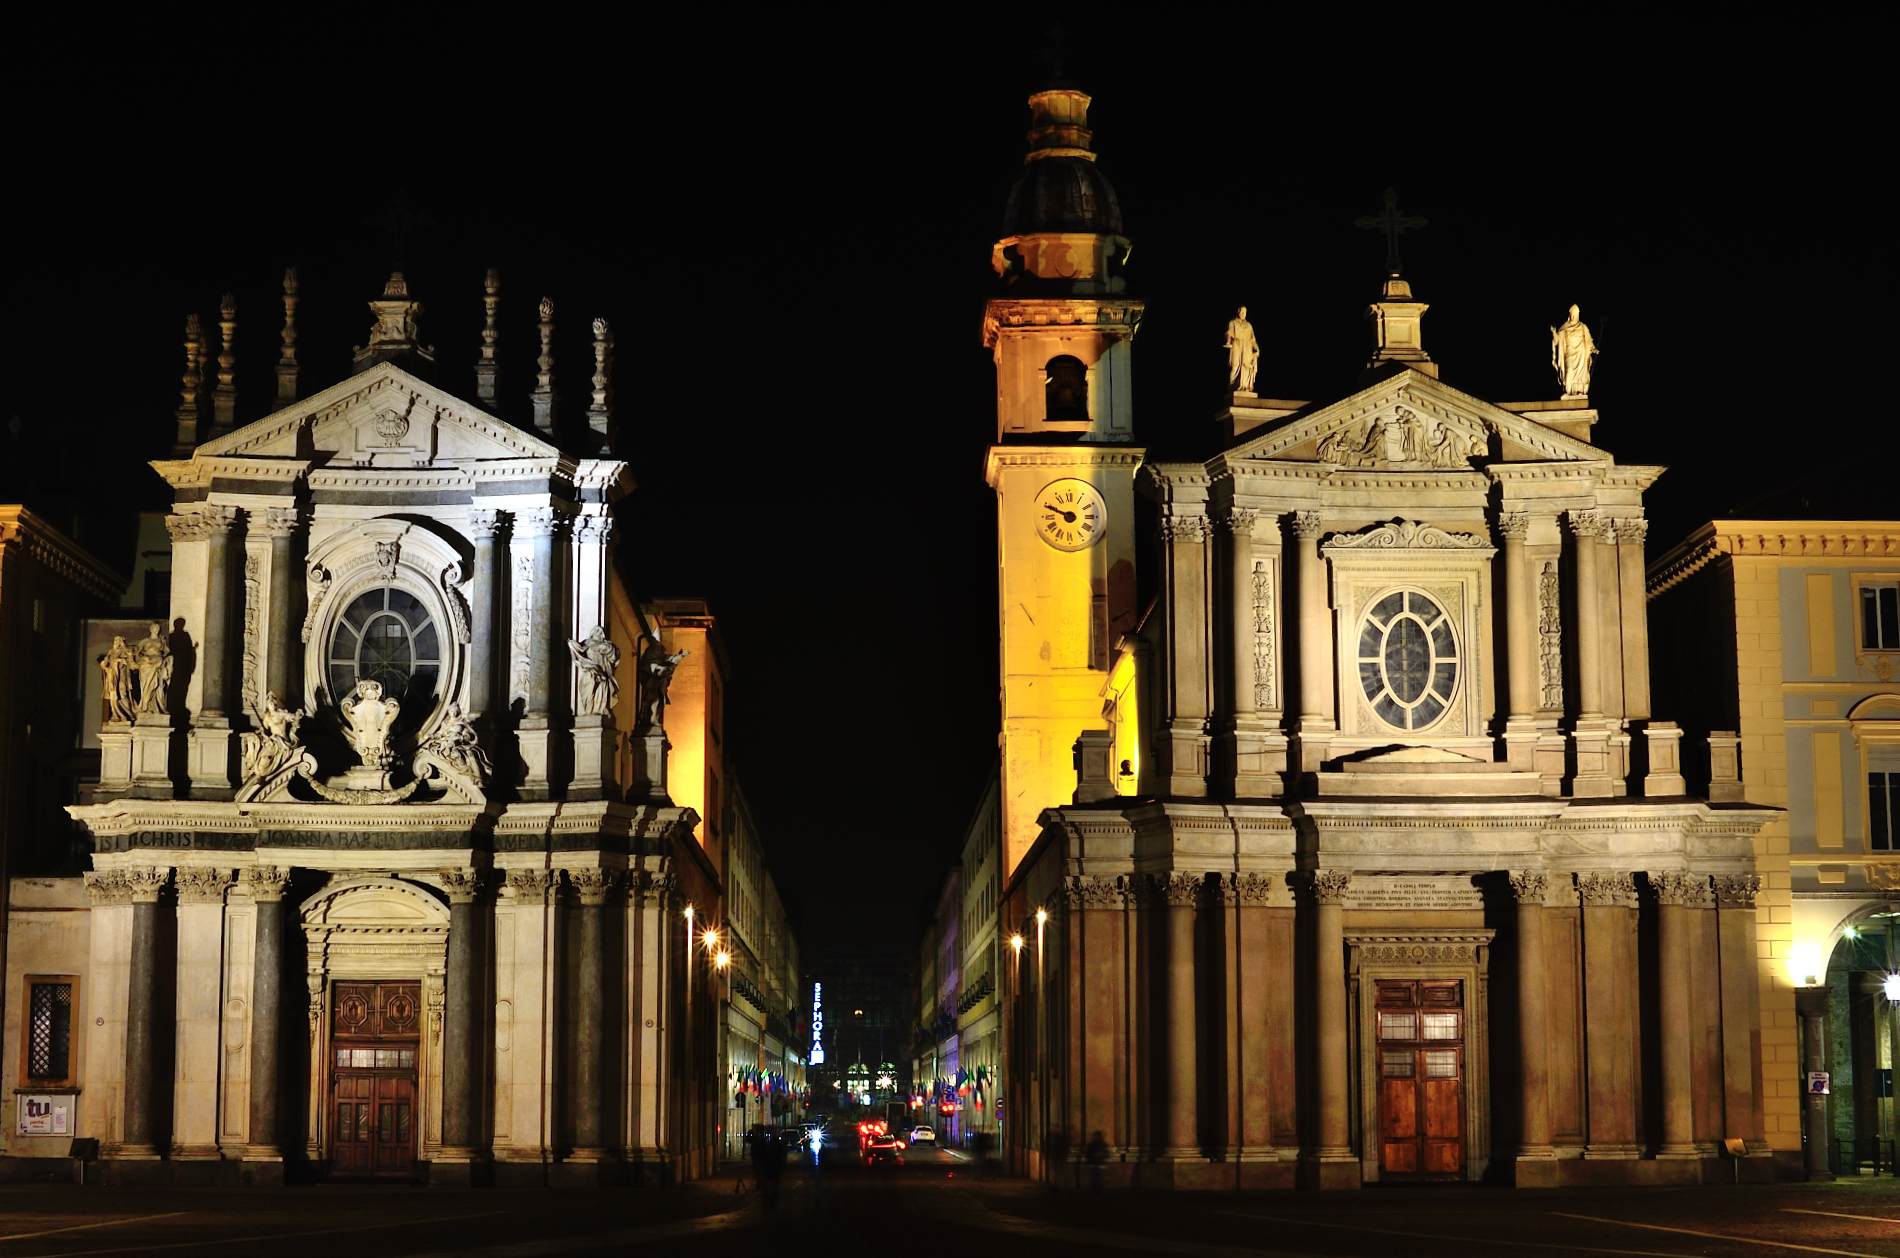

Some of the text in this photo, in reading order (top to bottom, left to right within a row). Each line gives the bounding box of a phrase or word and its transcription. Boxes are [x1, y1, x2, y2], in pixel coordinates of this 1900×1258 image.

[261, 830, 334, 847] JOANNA
[812, 982, 823, 1051] SEPHORA
[26, 1099, 50, 1118] tu
